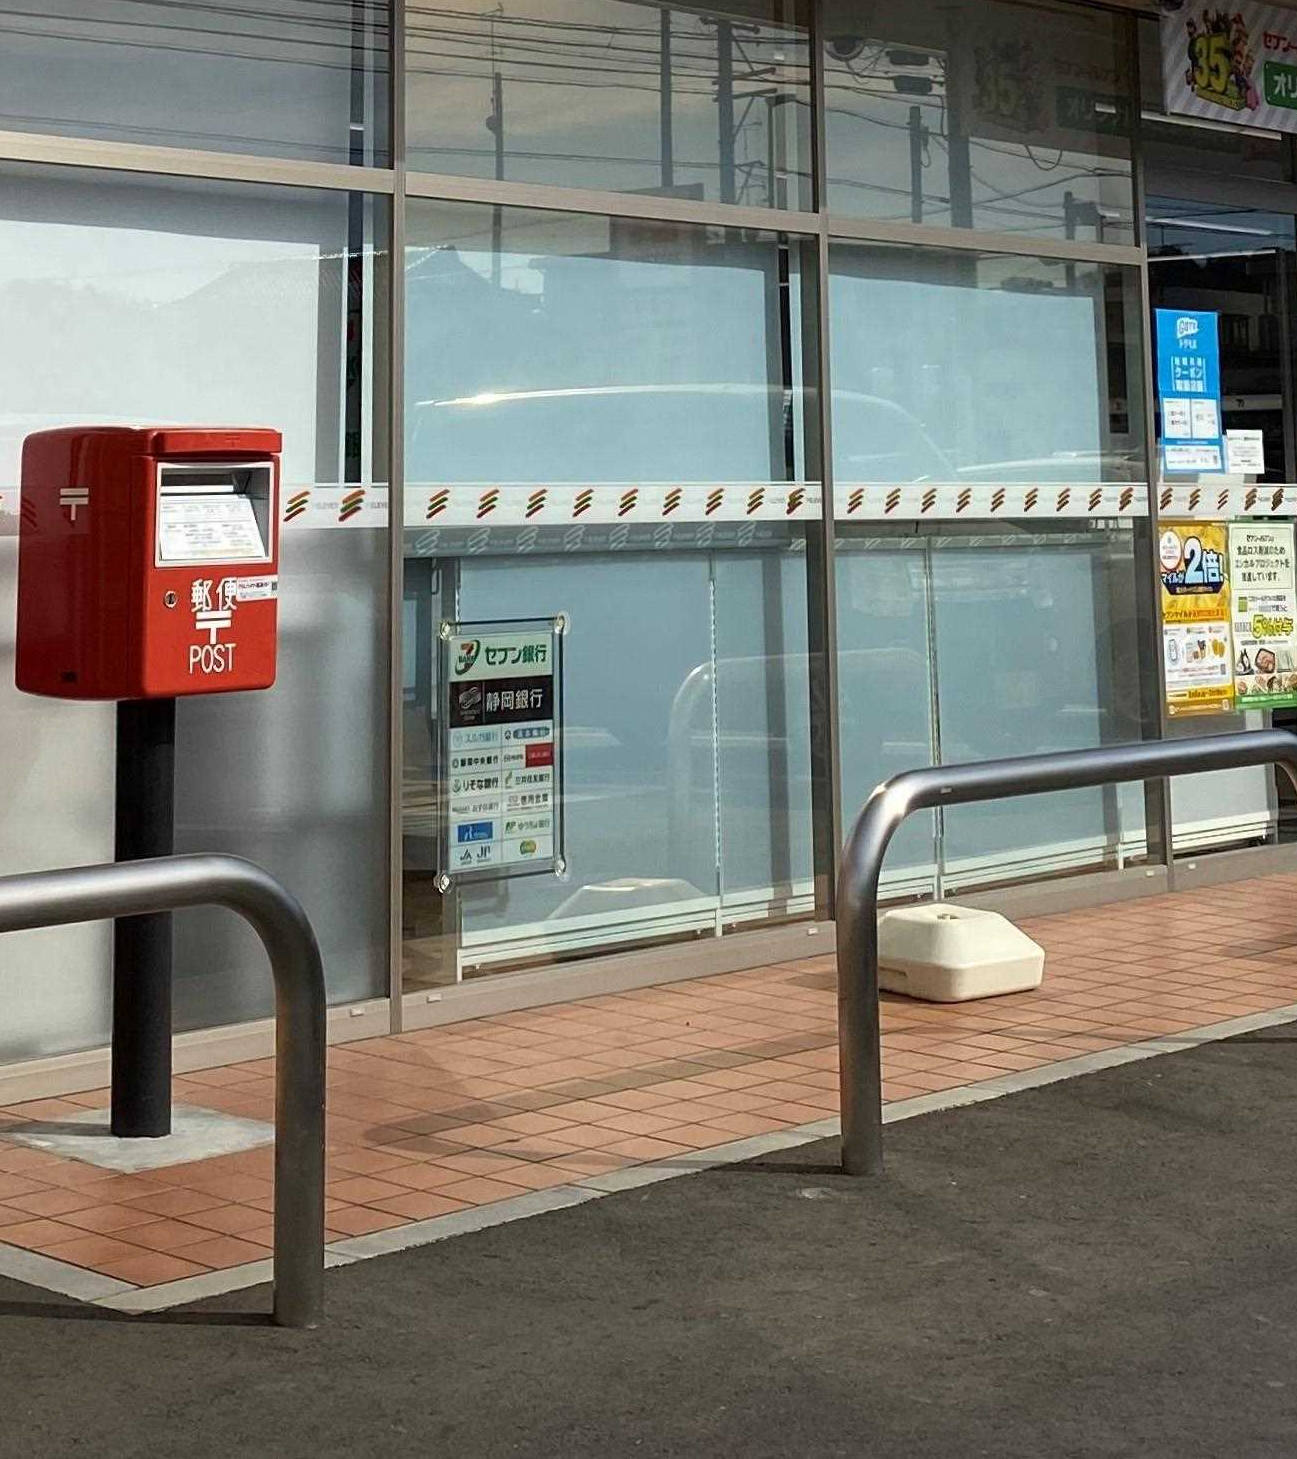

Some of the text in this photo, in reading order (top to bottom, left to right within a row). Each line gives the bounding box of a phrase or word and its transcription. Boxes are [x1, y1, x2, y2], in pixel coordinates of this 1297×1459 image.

[1194, 34, 1230, 94] 35
[191, 577, 237, 612] 郵便
[189, 643, 237, 674] POST
[485, 644, 547, 665] セブン銀行
[486, 688, 543, 712] 静岡銀行
[463, 777, 499, 791] りそな銀行
